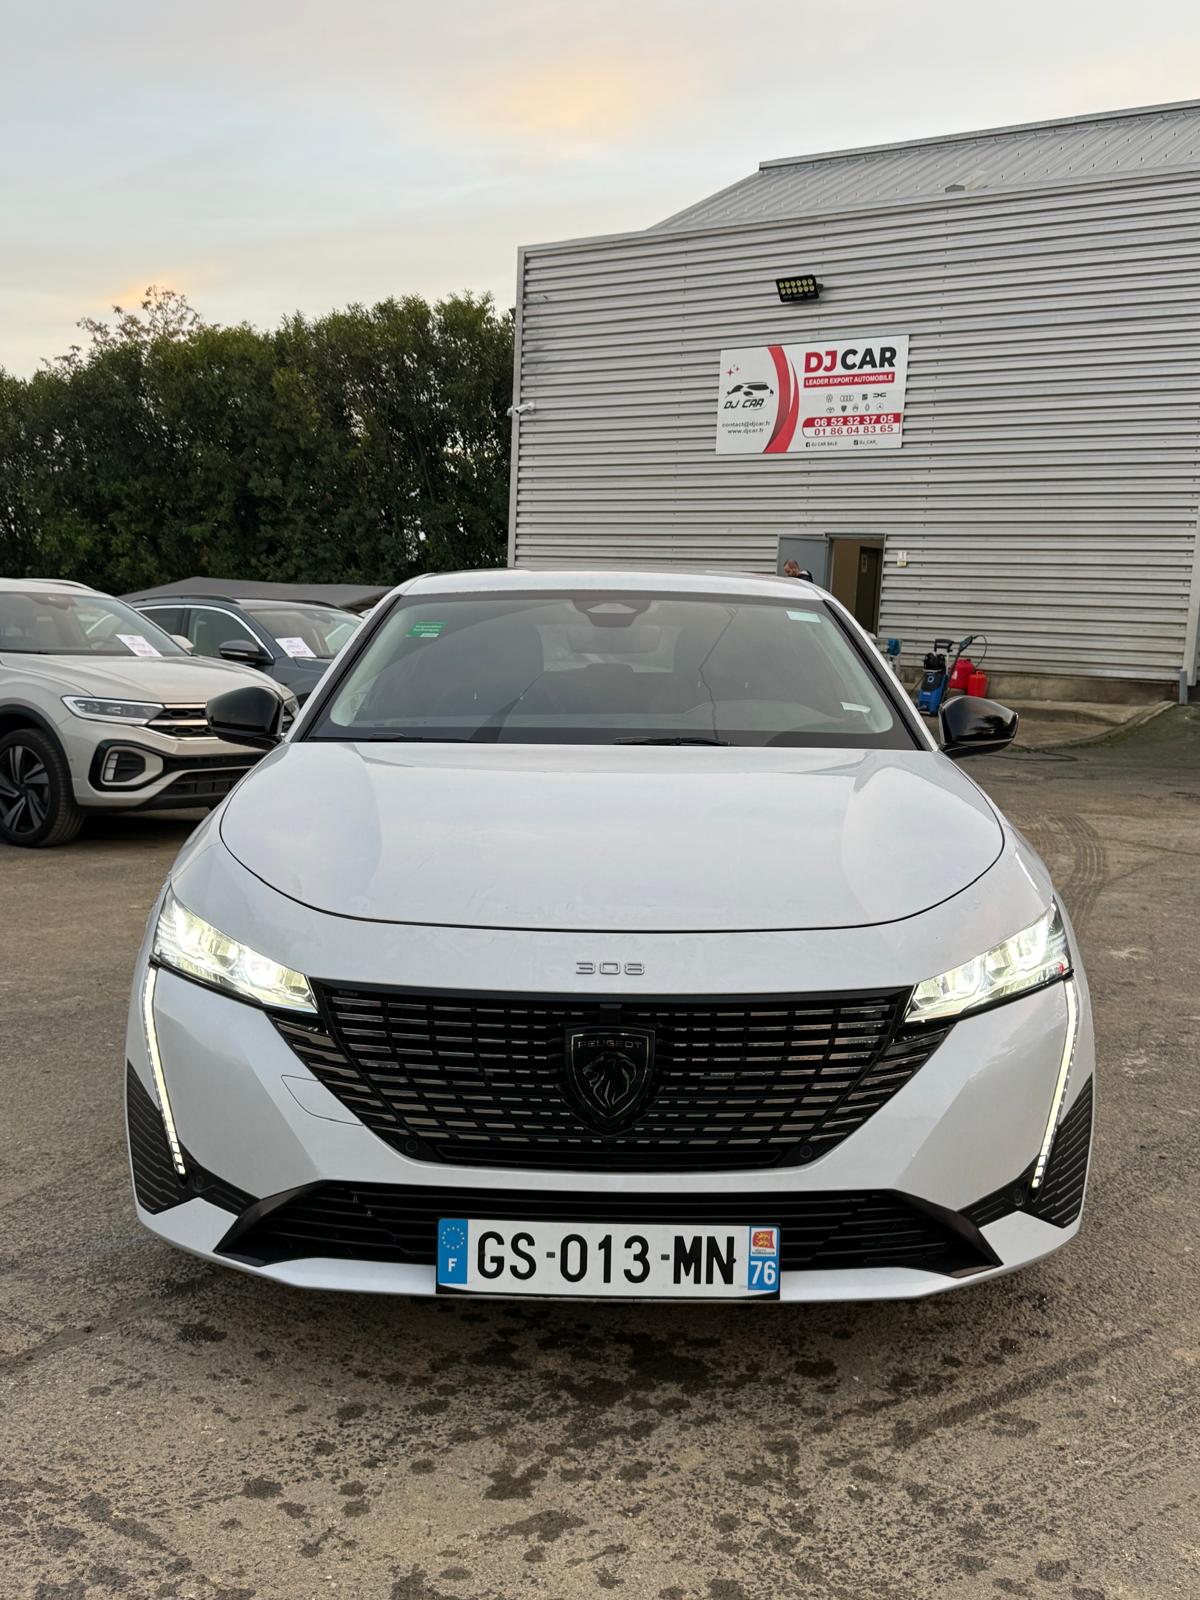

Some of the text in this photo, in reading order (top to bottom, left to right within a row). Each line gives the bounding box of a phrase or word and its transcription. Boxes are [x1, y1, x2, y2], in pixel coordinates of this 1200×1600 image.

[804, 346, 897, 373] DJ CAR
[805, 373, 893, 386] LEADER EXPORT AUTOMOBILE
[724, 398, 765, 409] DJ CAR
[814, 414, 894, 427] 06 52 32 37 05
[727, 427, 765, 435] www.djcar.fr
[814, 424, 894, 436] 01 86 04 83 65
[576, 961, 646, 976] 308
[577, 1039, 643, 1049] PEUGEOT
[477, 1230, 736, 1286] GS-013-MN
[447, 1257, 458, 1273] F
[750, 1260, 777, 1286] 76
